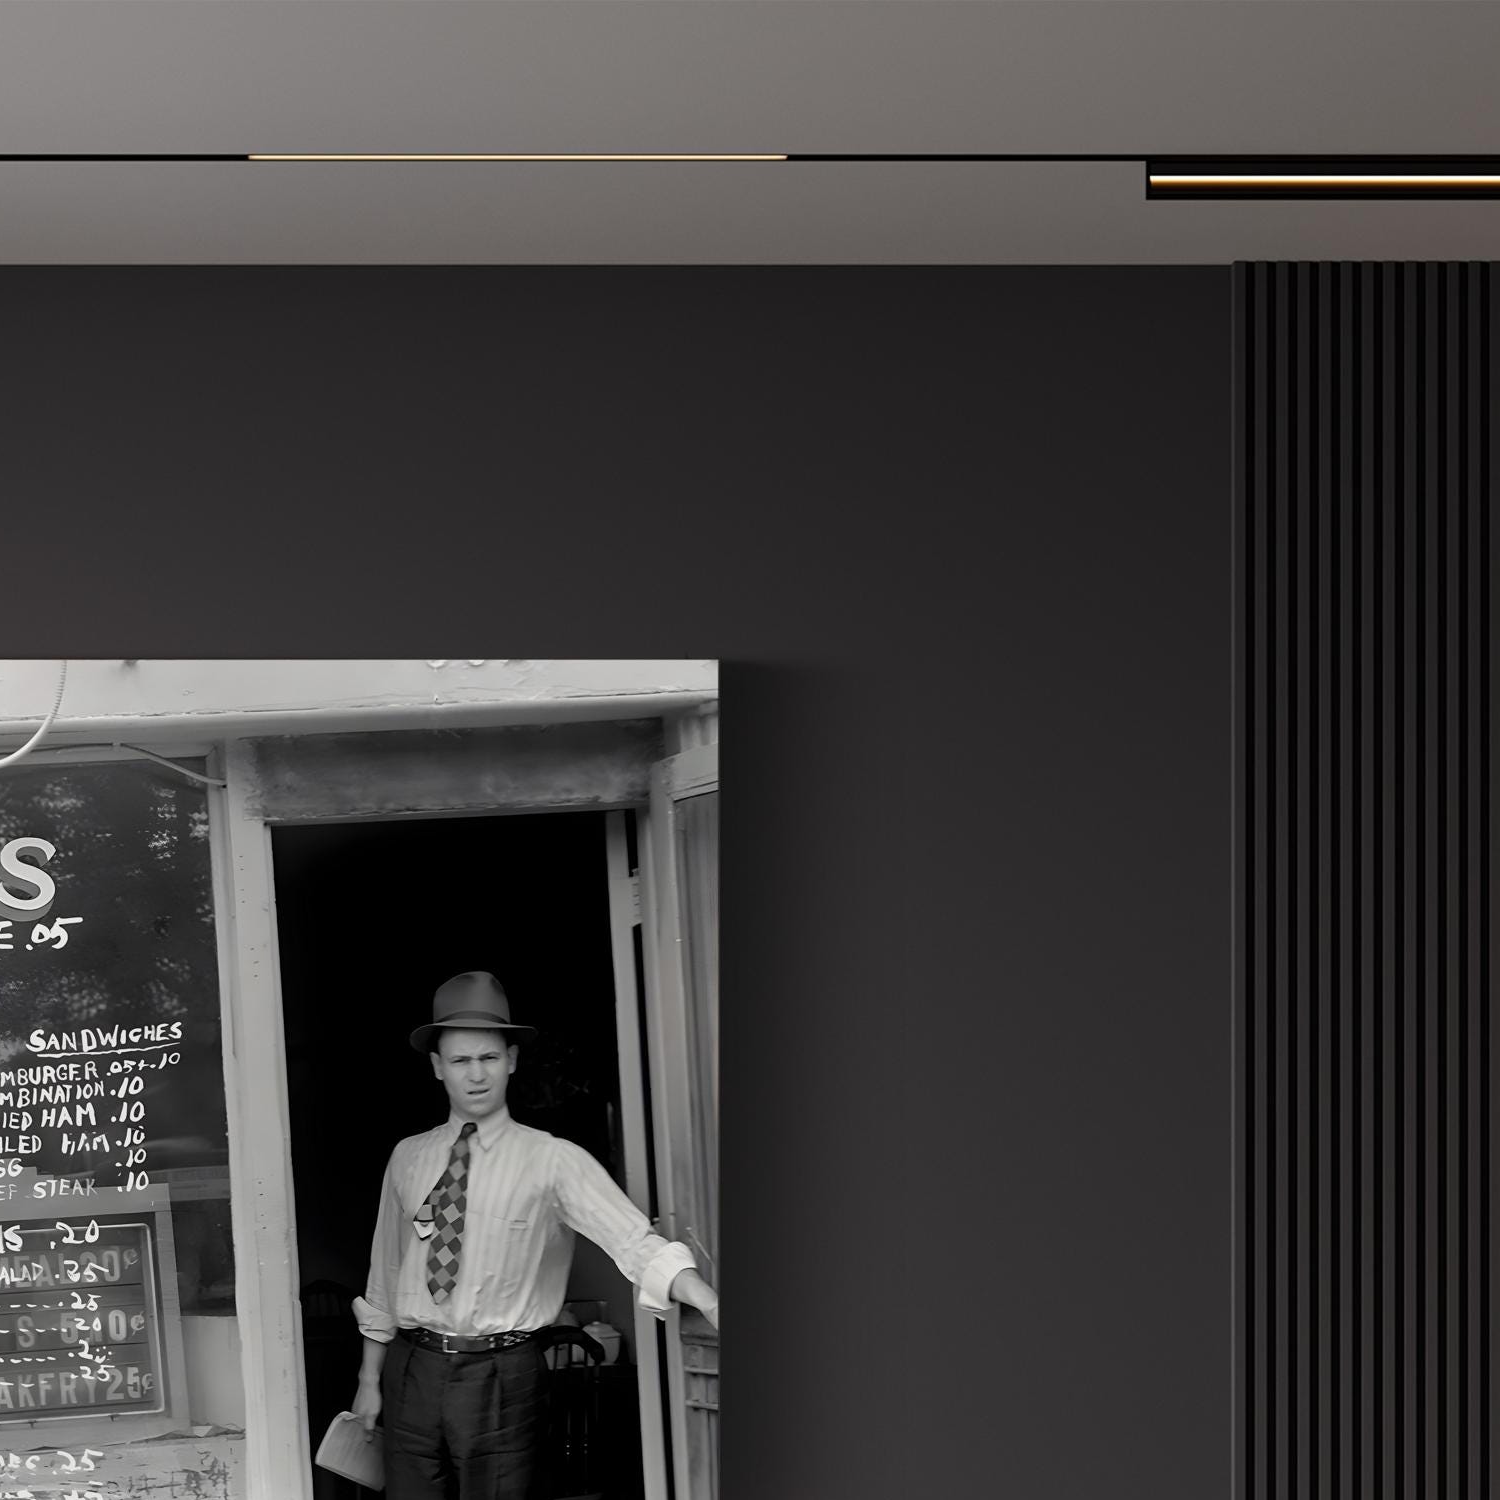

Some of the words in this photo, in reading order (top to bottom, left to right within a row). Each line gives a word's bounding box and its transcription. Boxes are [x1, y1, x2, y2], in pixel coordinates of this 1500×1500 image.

[26, 916, 84, 951] .05
[26, 1022, 182, 1053] SANDWICHES
[110, 1076, 144, 1099] .10
[40, 1102, 97, 1129] HAM
[110, 1101, 145, 1123] .10
[61, 1132, 110, 1155] HAM
[32, 1178, 98, 1199] STEAK
